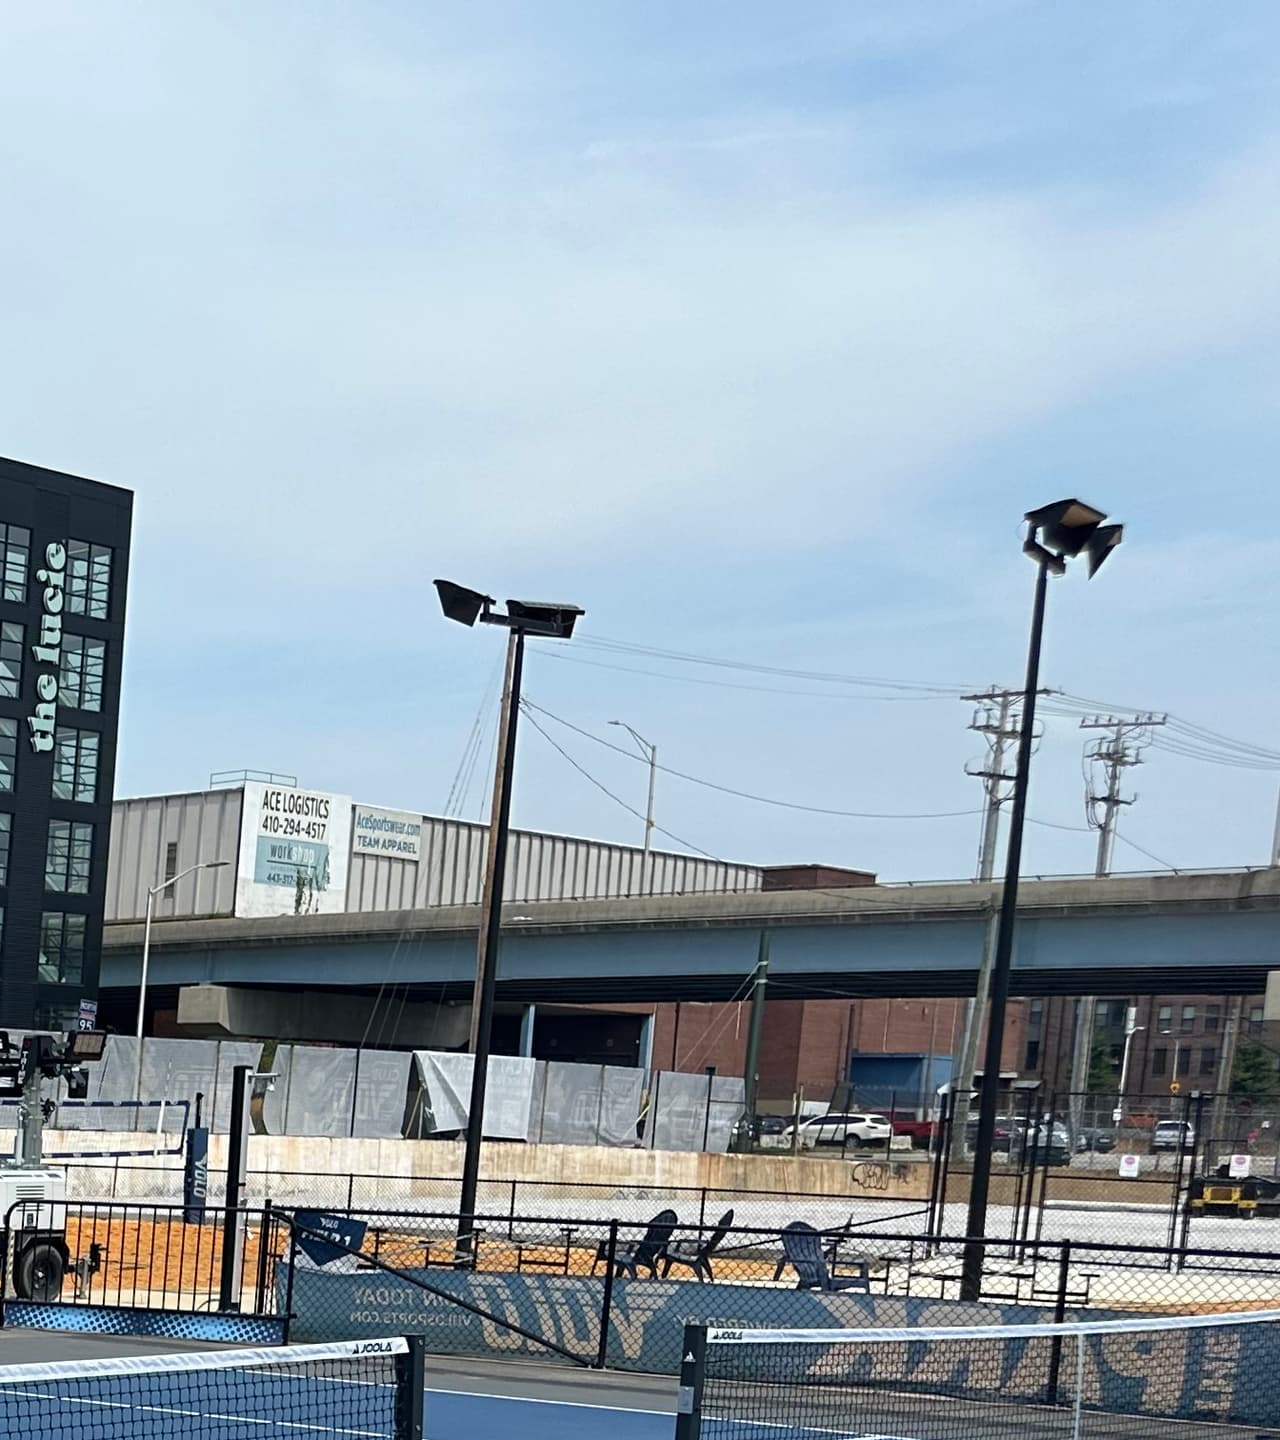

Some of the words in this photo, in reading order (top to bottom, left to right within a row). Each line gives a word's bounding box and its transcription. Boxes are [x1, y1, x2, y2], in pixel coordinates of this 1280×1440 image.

[32, 542, 67, 665] lucie
[27, 674, 57, 752] the
[262, 790, 281, 811] ACE
[283, 793, 329, 819] LOGISTICS
[262, 815, 326, 840] 410-294-4517
[356, 813, 421, 837] AceSportswear.com
[357, 835, 379, 850] TEAM
[381, 839, 417, 854] APPAREL
[80, 1020, 93, 1030] 95
[194, 1153, 207, 1198] VOLO
[344, 1236, 351, 1246] 1
[360, 1341, 392, 1354] JOOLA
